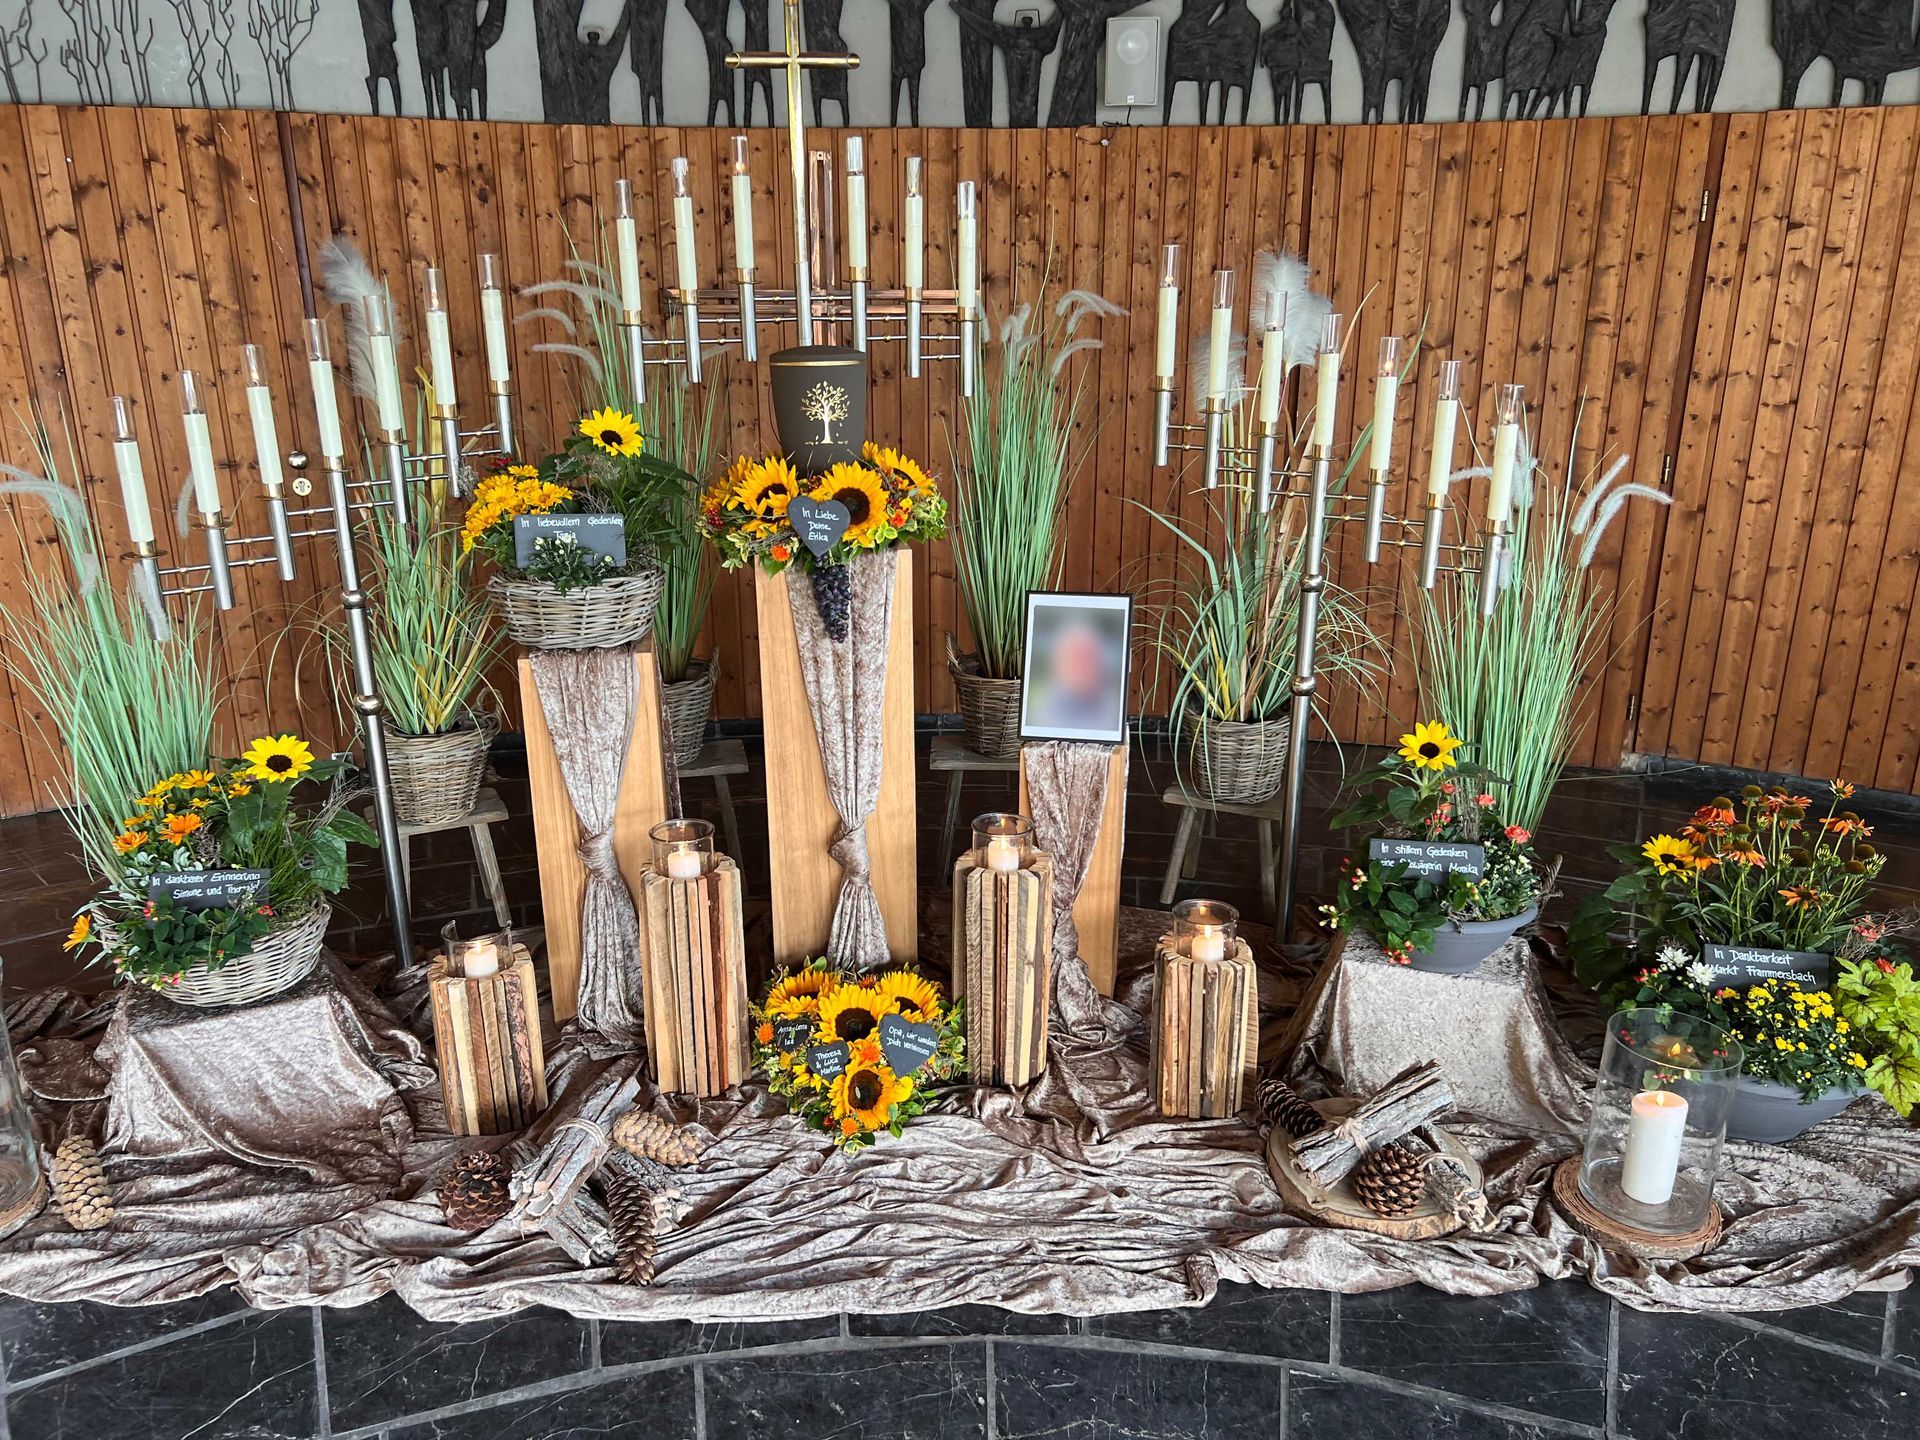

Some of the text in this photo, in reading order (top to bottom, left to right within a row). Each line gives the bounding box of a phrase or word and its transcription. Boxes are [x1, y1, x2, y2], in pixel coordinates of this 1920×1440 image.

[802, 507, 839, 520] In Liebe
[521, 518, 529, 527] In
[808, 521, 831, 531] Deine
[808, 532, 828, 542] Erika
[1381, 843, 1468, 859] In stillem Gedenken
[1449, 862, 1479, 875] Monika
[153, 877, 160, 886] In
[173, 888, 204, 899] Simone
[207, 886, 222, 896] und
[1714, 948, 1793, 966] In Dankbarkeit
[1746, 966, 1816, 984] Frammersbach
